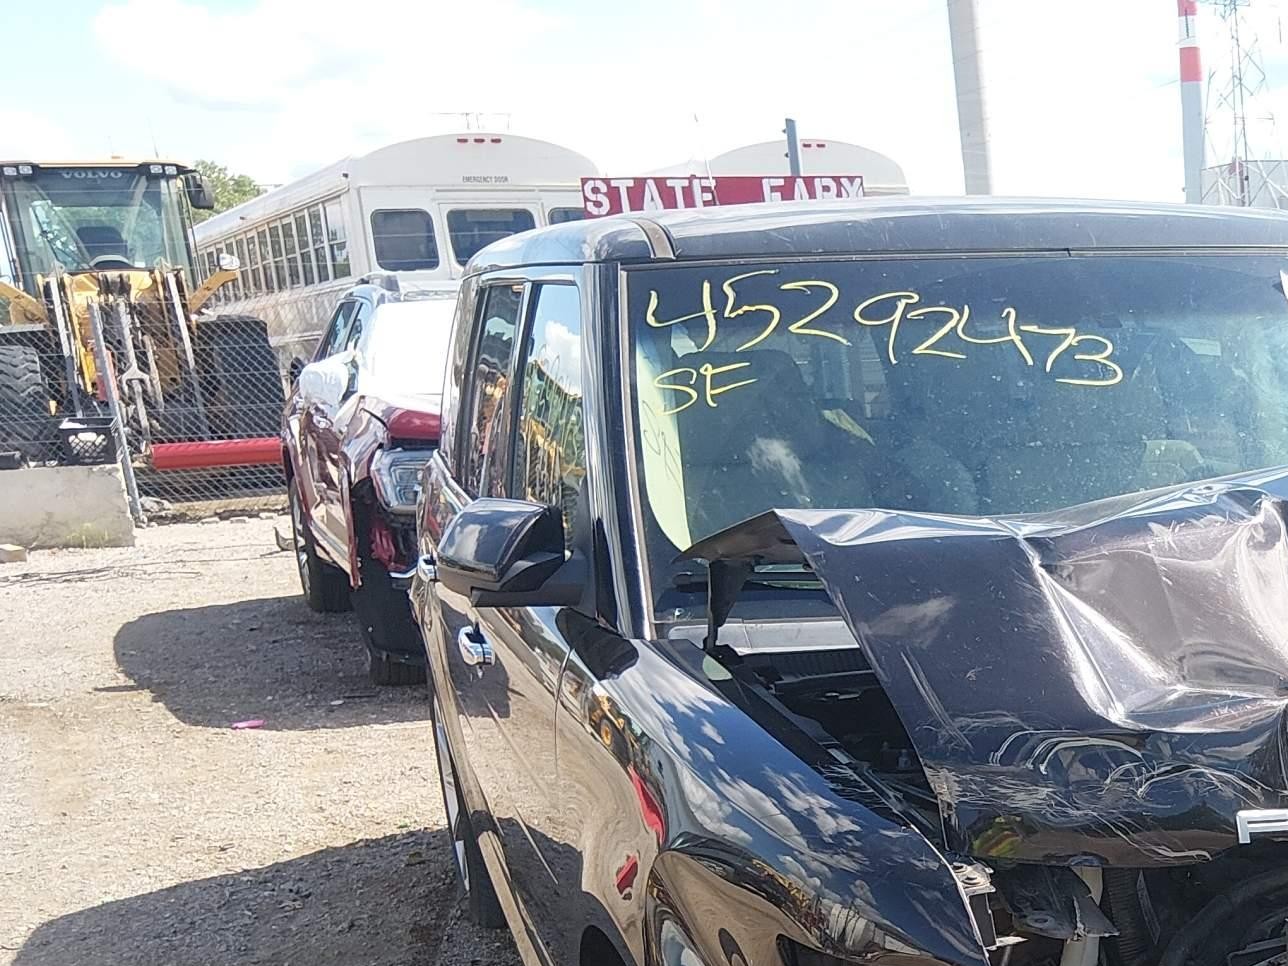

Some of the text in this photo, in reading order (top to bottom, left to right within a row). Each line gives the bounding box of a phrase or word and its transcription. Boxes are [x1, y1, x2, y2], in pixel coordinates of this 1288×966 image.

[61, 170, 122, 179] VOLVO
[583, 178, 719, 216] STATE
[646, 269, 1123, 386] 45292473
